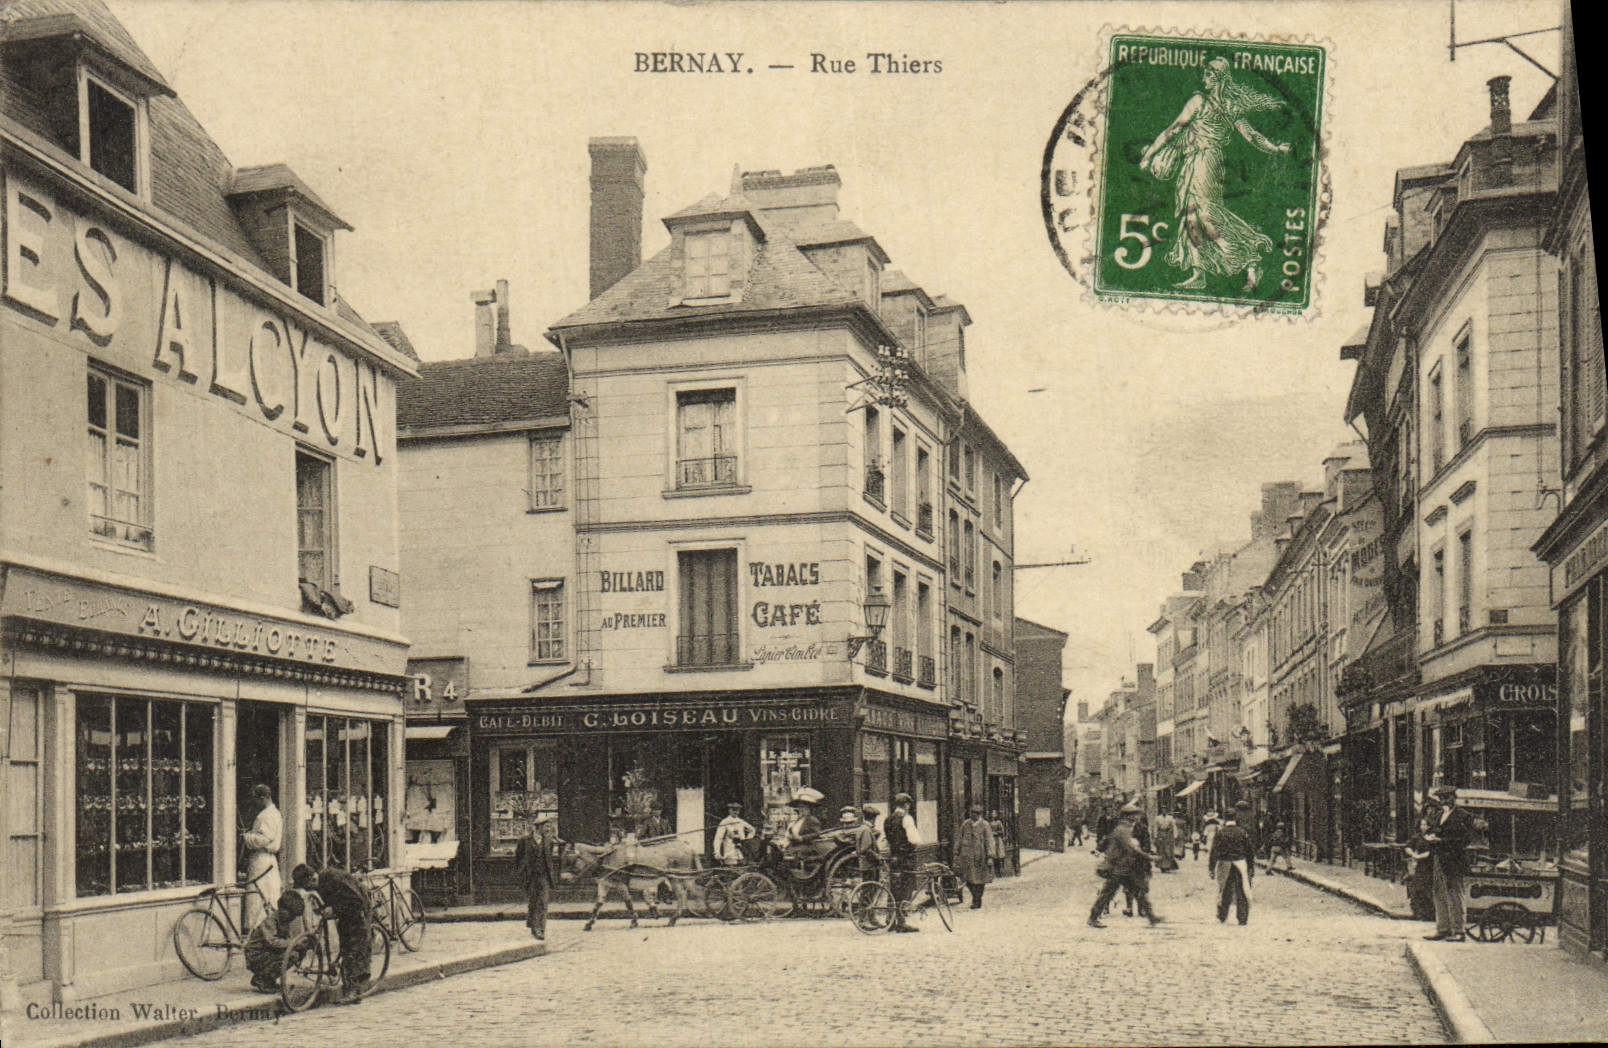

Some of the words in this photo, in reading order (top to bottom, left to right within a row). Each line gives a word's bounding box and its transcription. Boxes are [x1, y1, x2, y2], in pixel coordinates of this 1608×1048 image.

[1233, 51, 1317, 76] FRANÇAISE
[1281, 206, 1307, 292] POSTES
[152, 255, 383, 467] ALCYON
[600, 570, 665, 593] BILLARD
[748, 561, 820, 587] TABACS
[137, 603, 171, 637] A.
[601, 616, 613, 629] AU
[614, 612, 667, 631] PREMIER
[751, 599, 824, 628] CAFÉ
[443, 680, 458, 700] 4
[612, 708, 739, 727] LOISEAU
